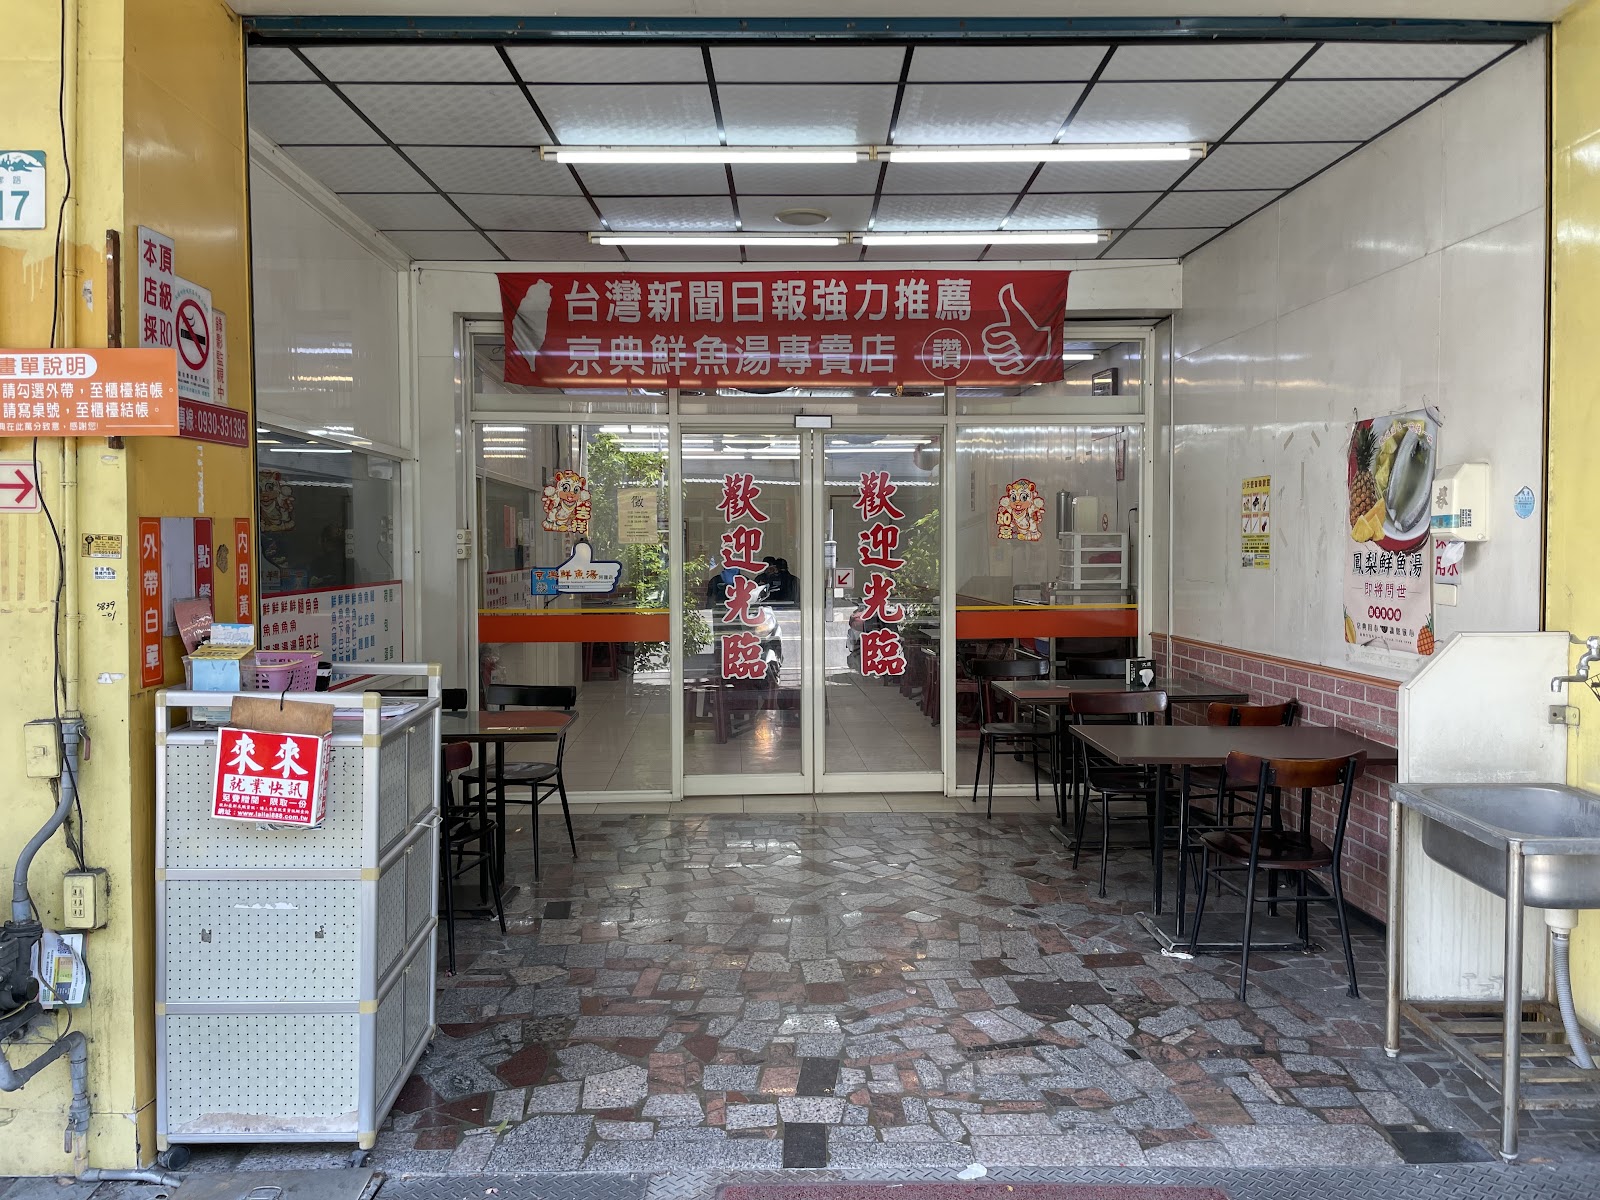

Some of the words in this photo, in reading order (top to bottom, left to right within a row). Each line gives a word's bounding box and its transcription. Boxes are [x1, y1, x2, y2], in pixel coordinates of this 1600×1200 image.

[564, 278, 972, 323] 台灣新聞日報強力推薦
[0, 356, 86, 376] 畫單說明
[566, 334, 896, 376] 京典鮮魚湯專賣店
[931, 338, 964, 370] 讚
[237, 531, 250, 618] 內用黃
[716, 471, 770, 681] 歡迎光臨
[852, 469, 906, 678] 歡迎光臨
[1352, 551, 1423, 578] 鳳梨鮮魚湯
[143, 533, 160, 671] 外帶白單
[1364, 581, 1407, 599] 即將問世
[226, 732, 309, 779] 來來
[229, 776, 303, 798] 就業快訊
